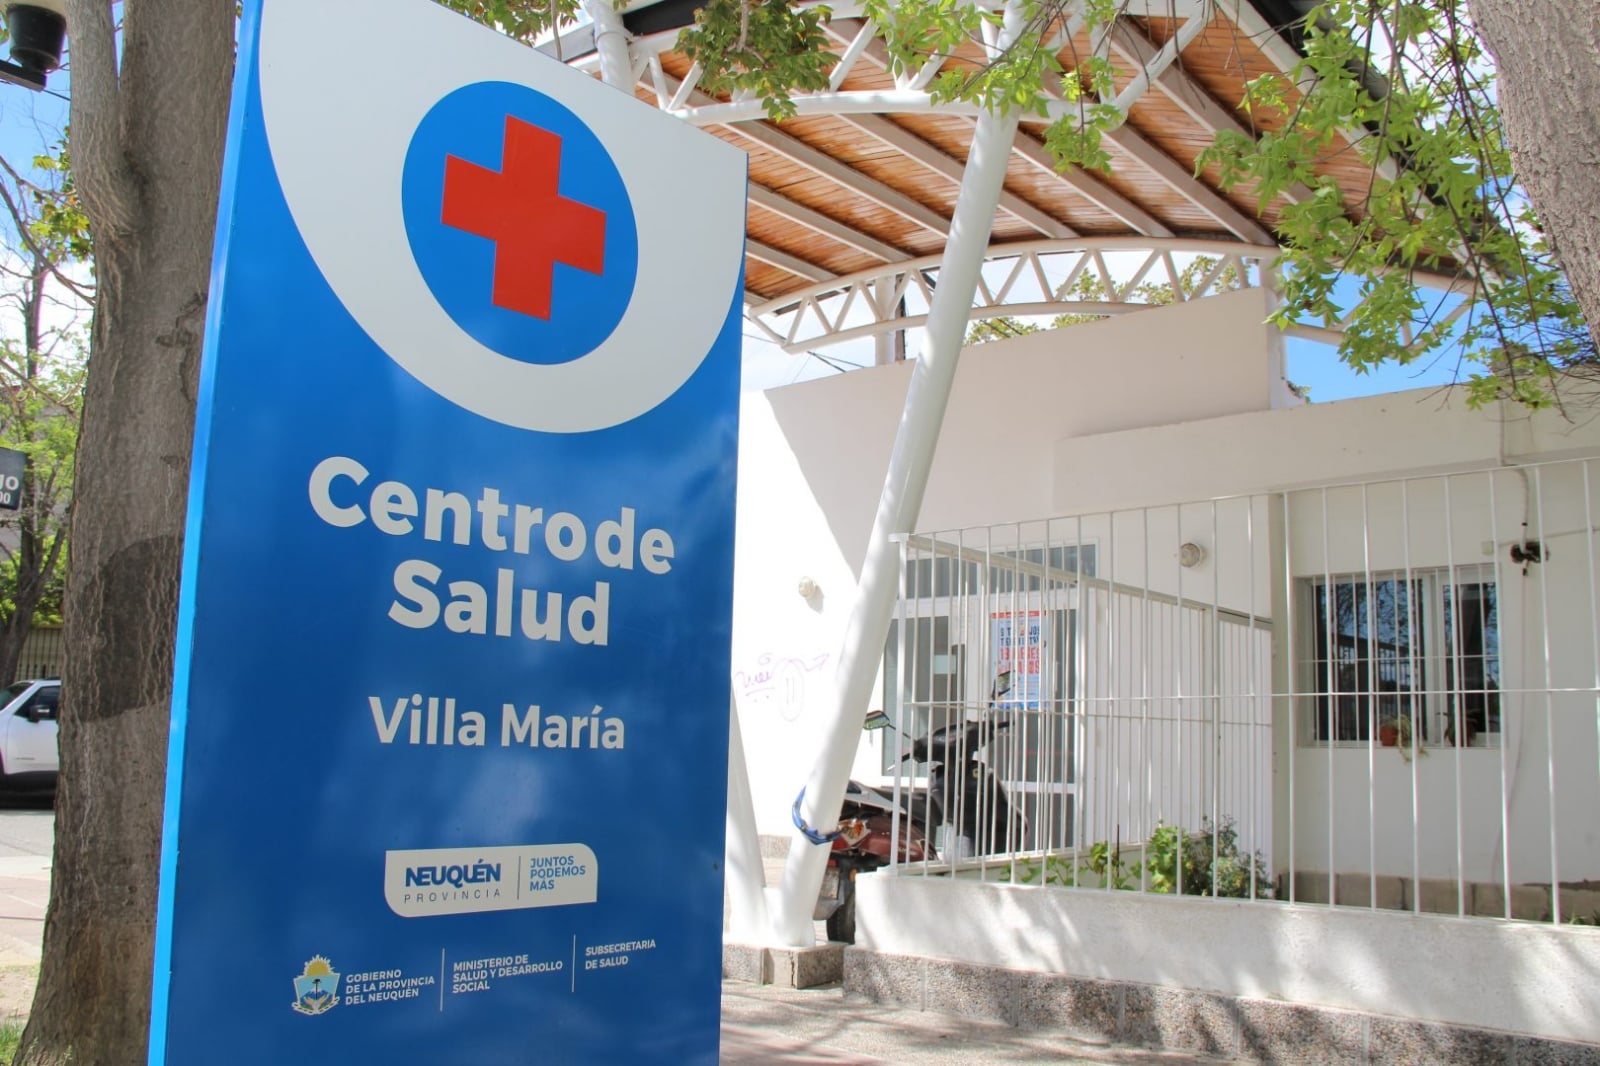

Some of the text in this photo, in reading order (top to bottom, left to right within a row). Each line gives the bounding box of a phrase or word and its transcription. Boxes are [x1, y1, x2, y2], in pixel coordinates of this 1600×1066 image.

[308, 456, 675, 575] Centro de
[387, 559, 610, 646] Salud
[368, 694, 625, 749] Villa María
[530, 856, 575, 868] JUNTOS
[405, 859, 501, 888] NEUQUÉN
[530, 865, 586, 879] PODEMOS
[404, 888, 500, 904] PROVINCIA
[585, 939, 656, 957] SUBSECRETARIA
[452, 960, 563, 983] SALUD Y DESARROLLO
[453, 954, 529, 972] MINISTERIO DE
[585, 955, 629, 970] DE SALUD
[346, 969, 402, 983] GOBIERNO
[346, 976, 435, 994] DE LA PROVINCIA
[345, 986, 419, 1005] DEL NEUQUÉN
[452, 981, 491, 994] SOCIAL
